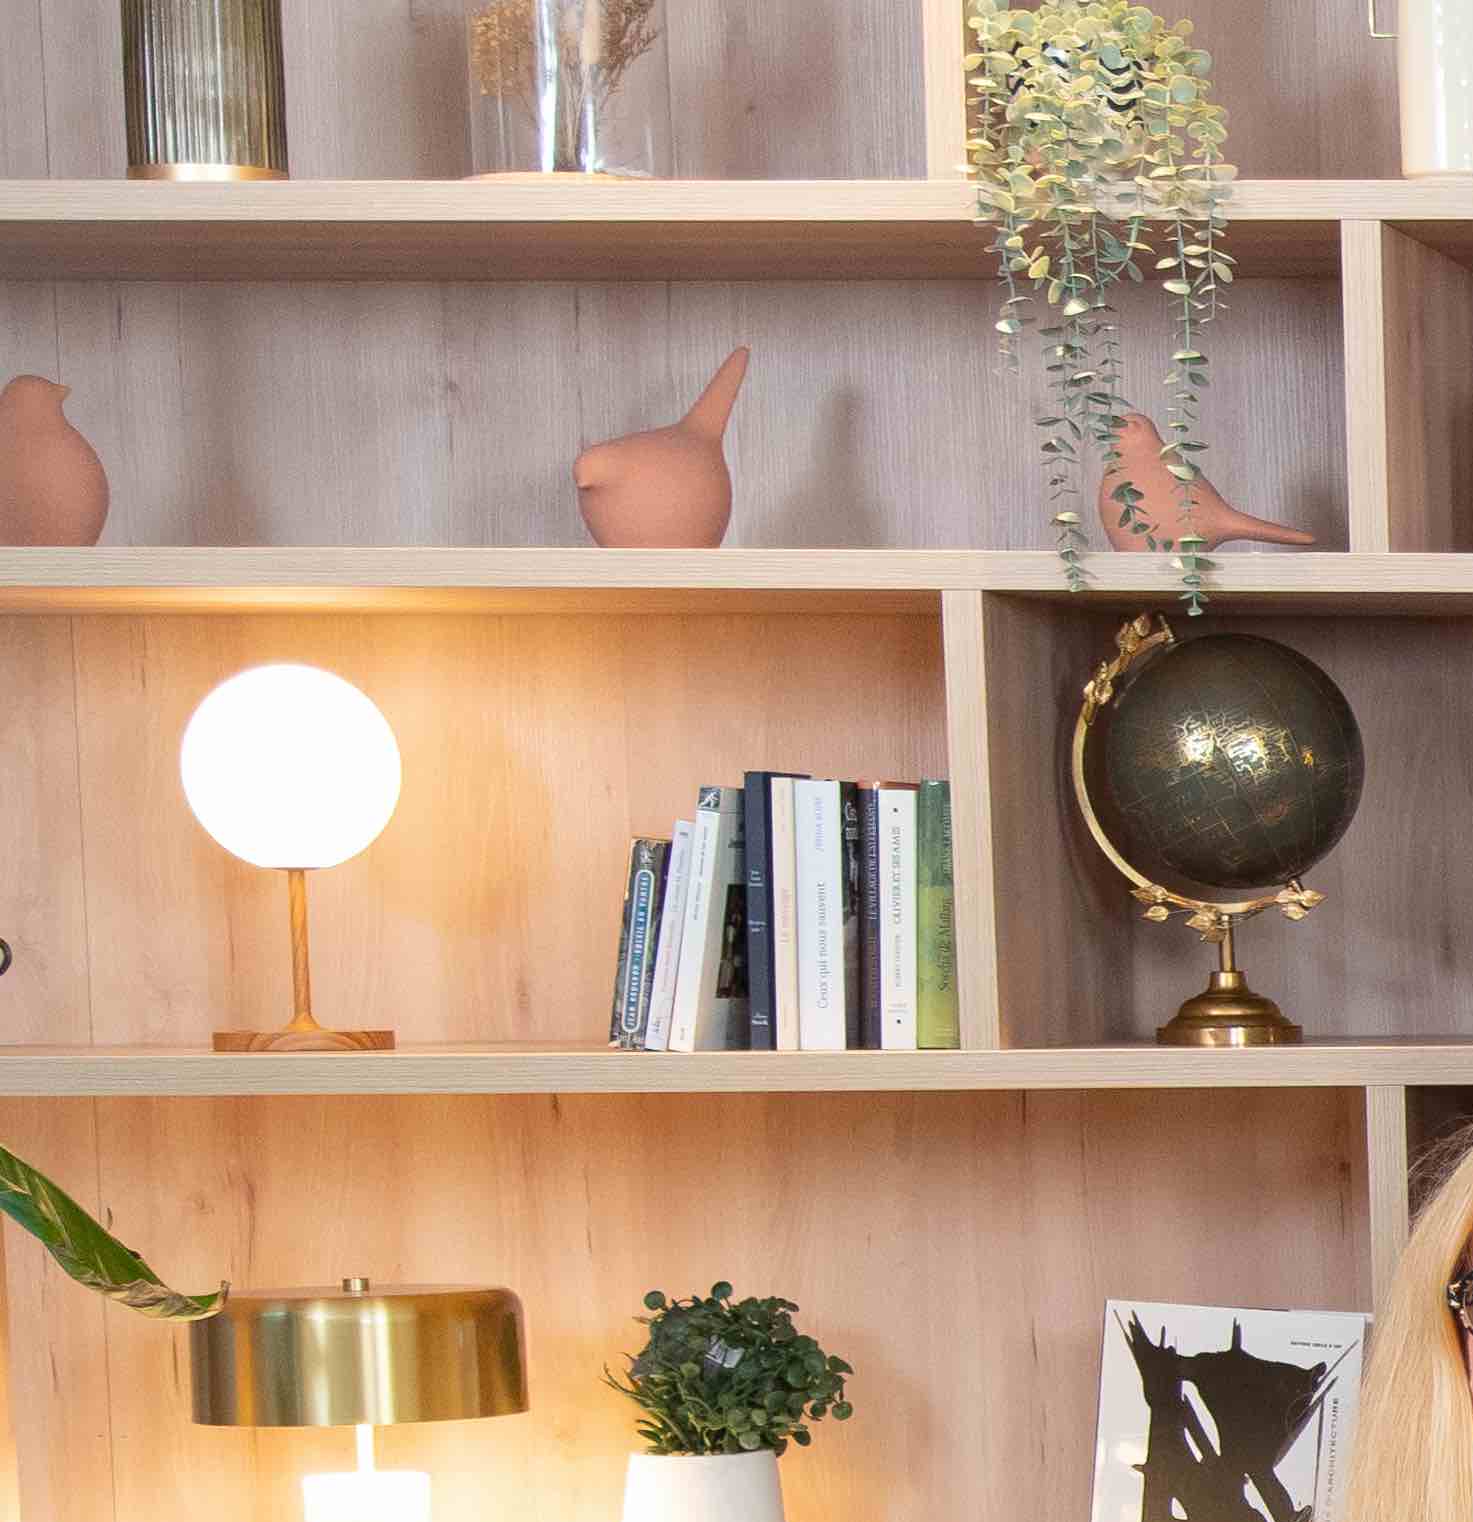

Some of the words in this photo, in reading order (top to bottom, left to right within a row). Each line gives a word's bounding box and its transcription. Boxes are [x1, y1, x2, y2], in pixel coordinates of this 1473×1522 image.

[815, 880, 828, 927] sauvent
[816, 929, 828, 958] nous
[816, 959, 831, 979] qui
[816, 979, 829, 1009] Ceux
